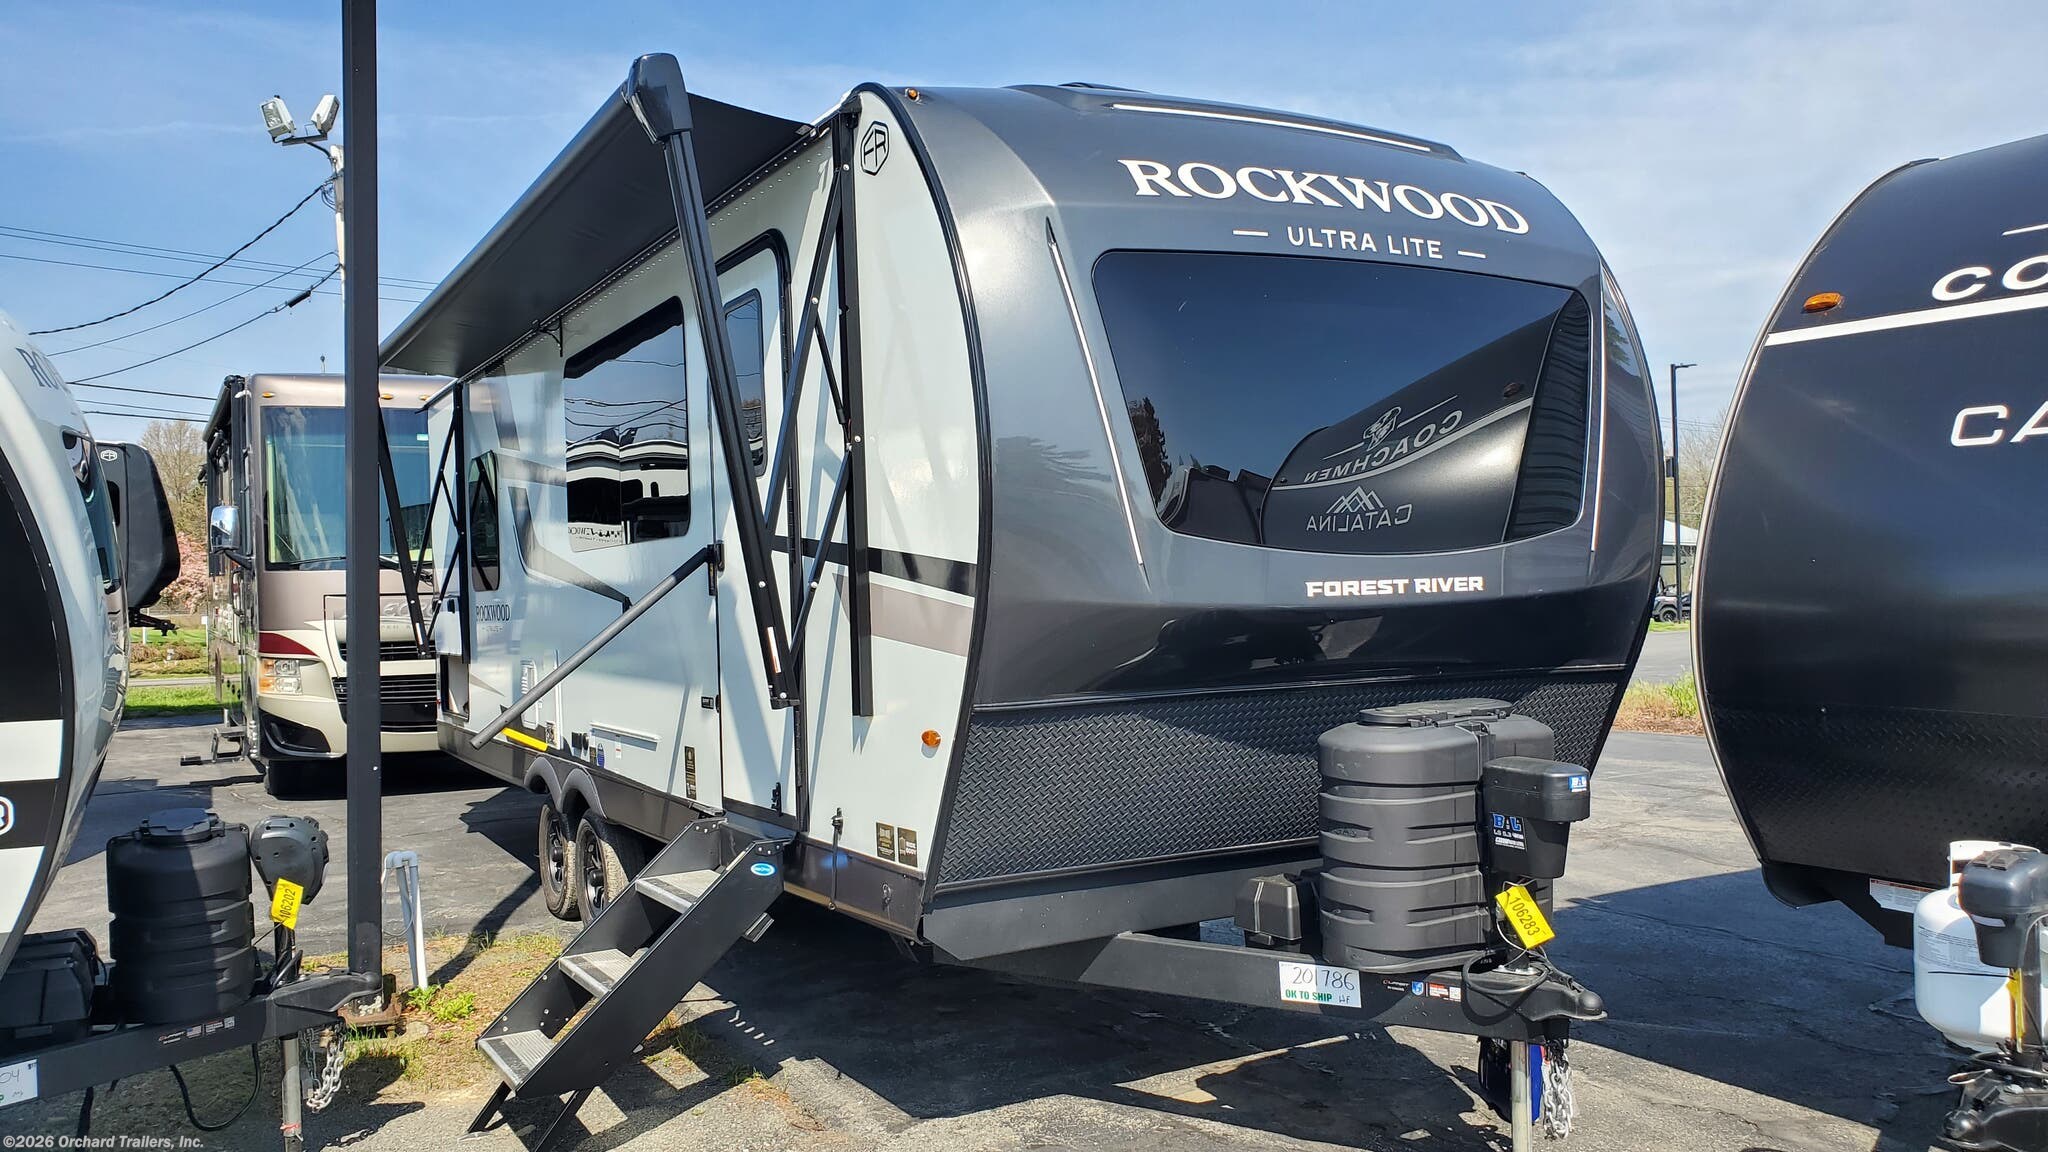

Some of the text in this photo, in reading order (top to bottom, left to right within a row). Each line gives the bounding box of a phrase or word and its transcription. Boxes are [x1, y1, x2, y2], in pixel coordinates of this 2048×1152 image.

[1117, 159, 1529, 235] ROCKWOOD
[1287, 226, 1443, 259] ULTRA LITE
[1305, 576, 1484, 597] FOREST RIVER
[279, 888, 296, 919] 106202
[1509, 897, 1540, 936] 106283
[1292, 966, 1355, 991] 201786
[1285, 989, 1333, 1002] OK TO SHIP
